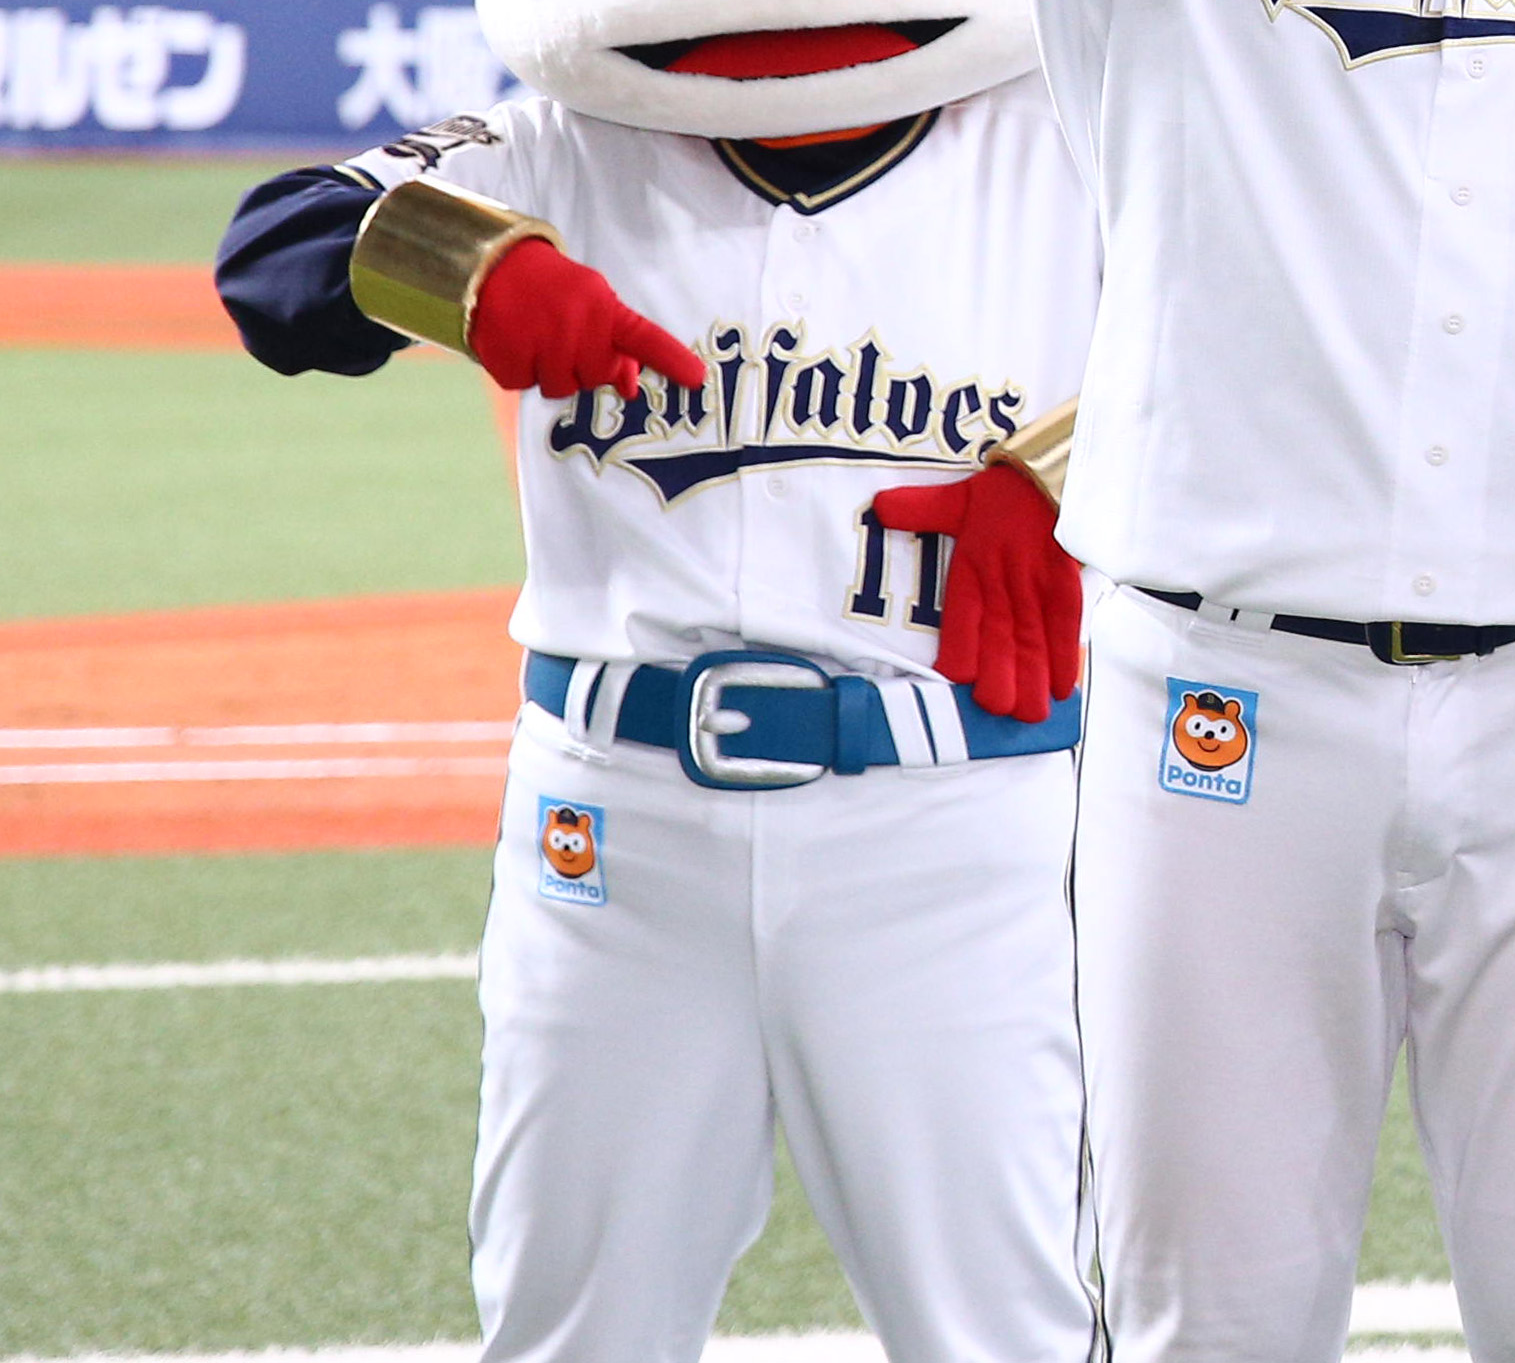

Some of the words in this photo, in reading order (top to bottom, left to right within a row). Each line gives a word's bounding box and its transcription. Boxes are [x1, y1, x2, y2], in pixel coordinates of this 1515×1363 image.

[0, 7, 245, 130] ルゼン
[843, 500, 953, 634] 11
[1167, 765, 1242, 796] Ponta
[545, 874, 600, 899] Ponta
